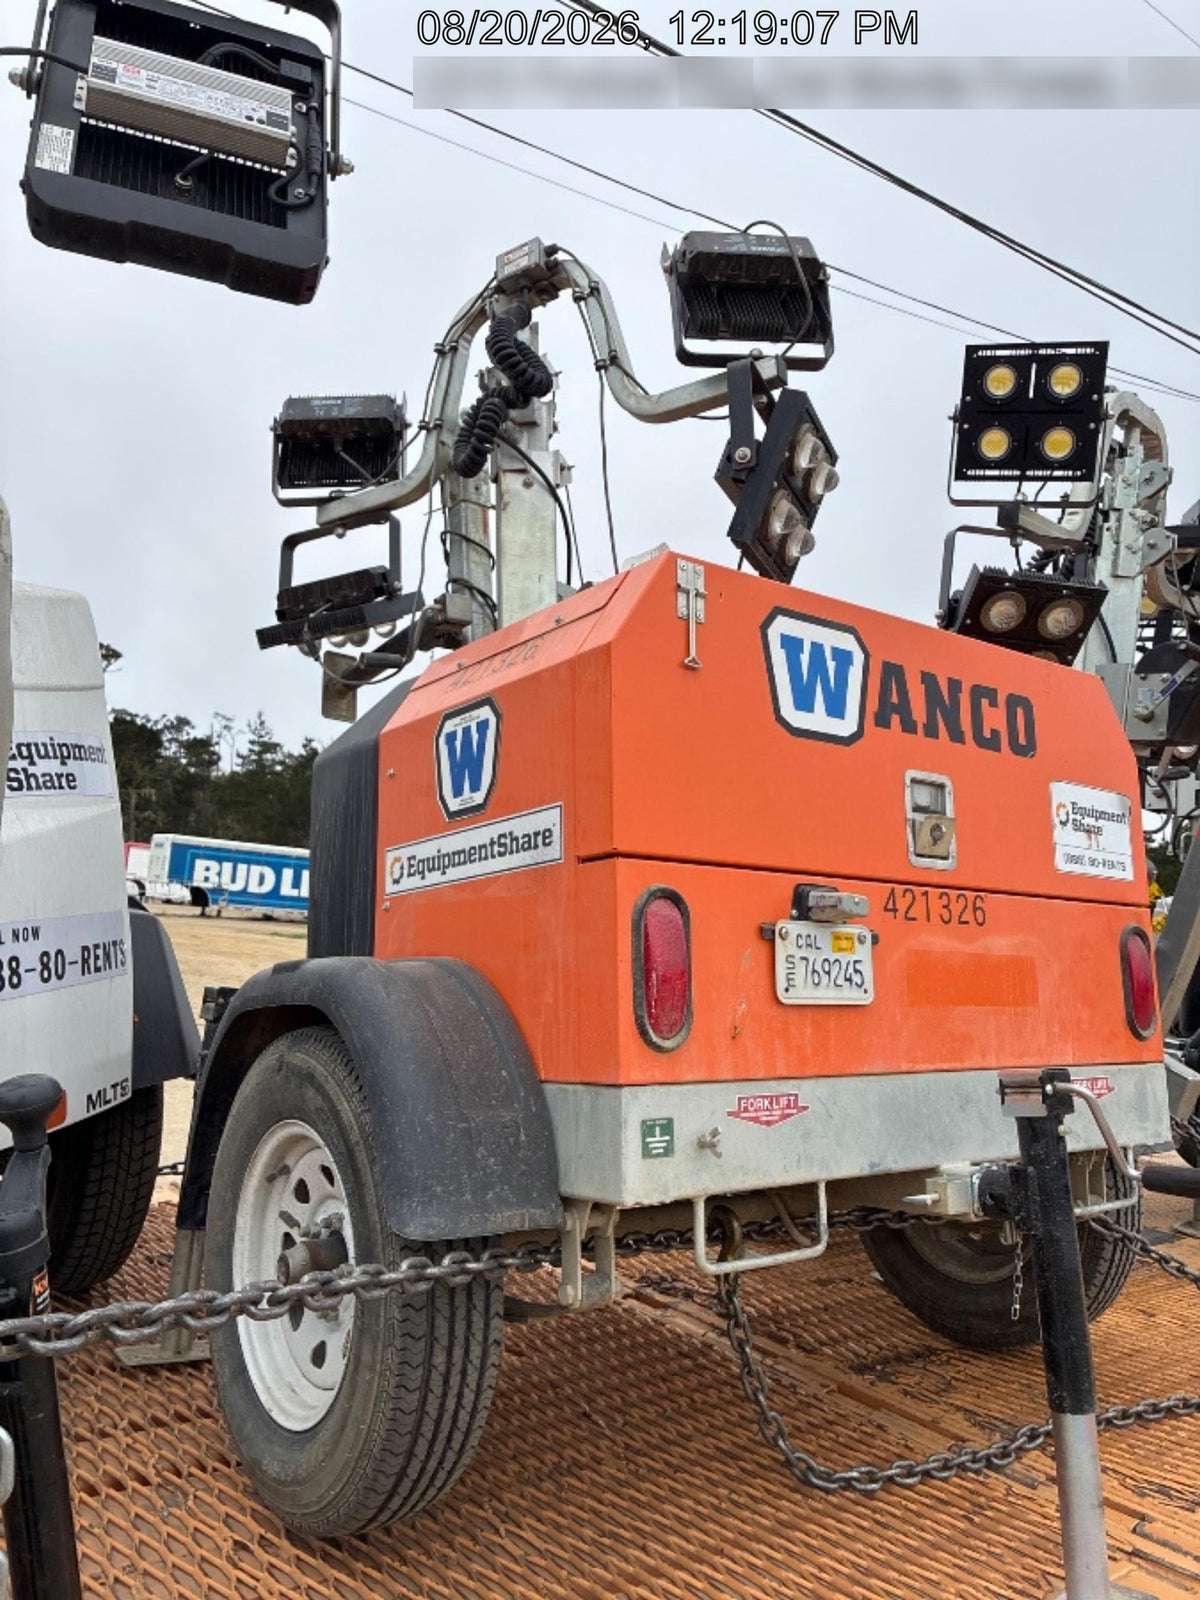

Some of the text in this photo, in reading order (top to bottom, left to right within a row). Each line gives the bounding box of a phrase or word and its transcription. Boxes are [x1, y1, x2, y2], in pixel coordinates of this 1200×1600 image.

[780, 632, 1037, 759] WANCO
[444, 717, 488, 799] W
[6, 767, 77, 791] Share
[1071, 801, 1127, 825] Equipment
[406, 827, 554, 881] EquipmentShare
[192, 858, 276, 894] BUD
[883, 887, 986, 927] 421326
[11, 926, 41, 943] NOW
[795, 933, 822, 950] CAL
[799, 956, 865, 990] 769245
